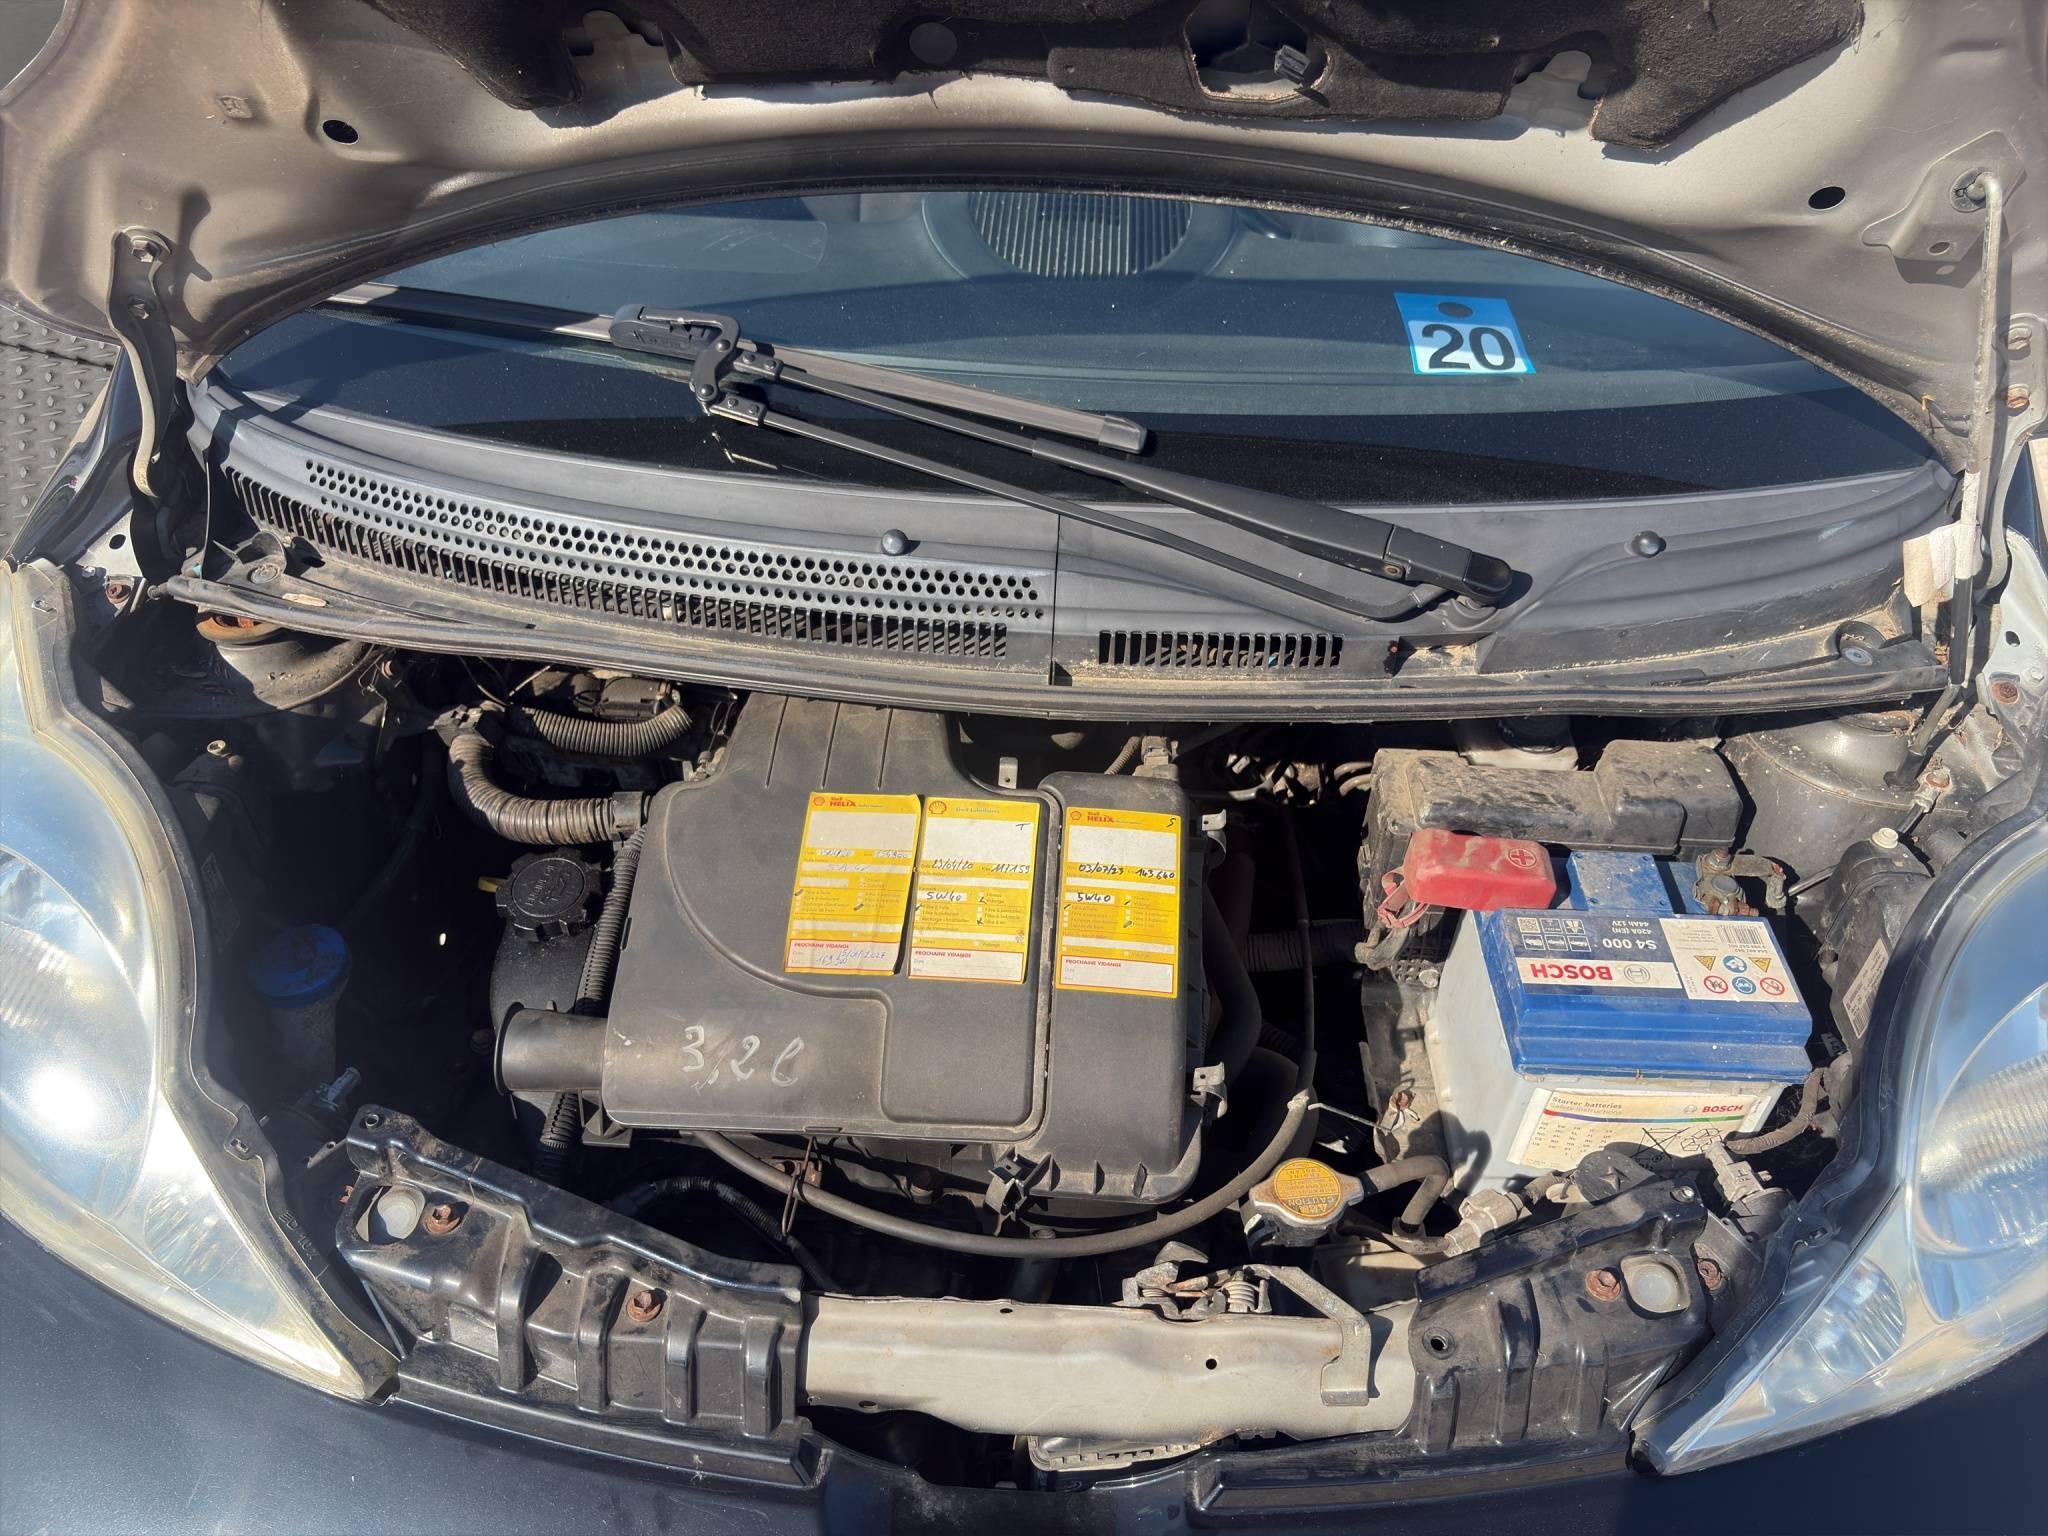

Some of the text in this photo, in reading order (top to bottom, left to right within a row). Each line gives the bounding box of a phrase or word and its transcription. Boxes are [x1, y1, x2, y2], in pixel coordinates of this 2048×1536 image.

[1422, 324, 1515, 370] 20
[1077, 892, 1112, 903] 5W40
[1630, 927, 1652, 935] 420A
[1602, 937, 1657, 950] S4 000
[1530, 963, 1613, 981] BOSCH
[1552, 1096, 1623, 1110] Starter batteries
[1701, 1104, 1744, 1114] BOSCH
[1288, 1196, 1335, 1206] CAUTION
